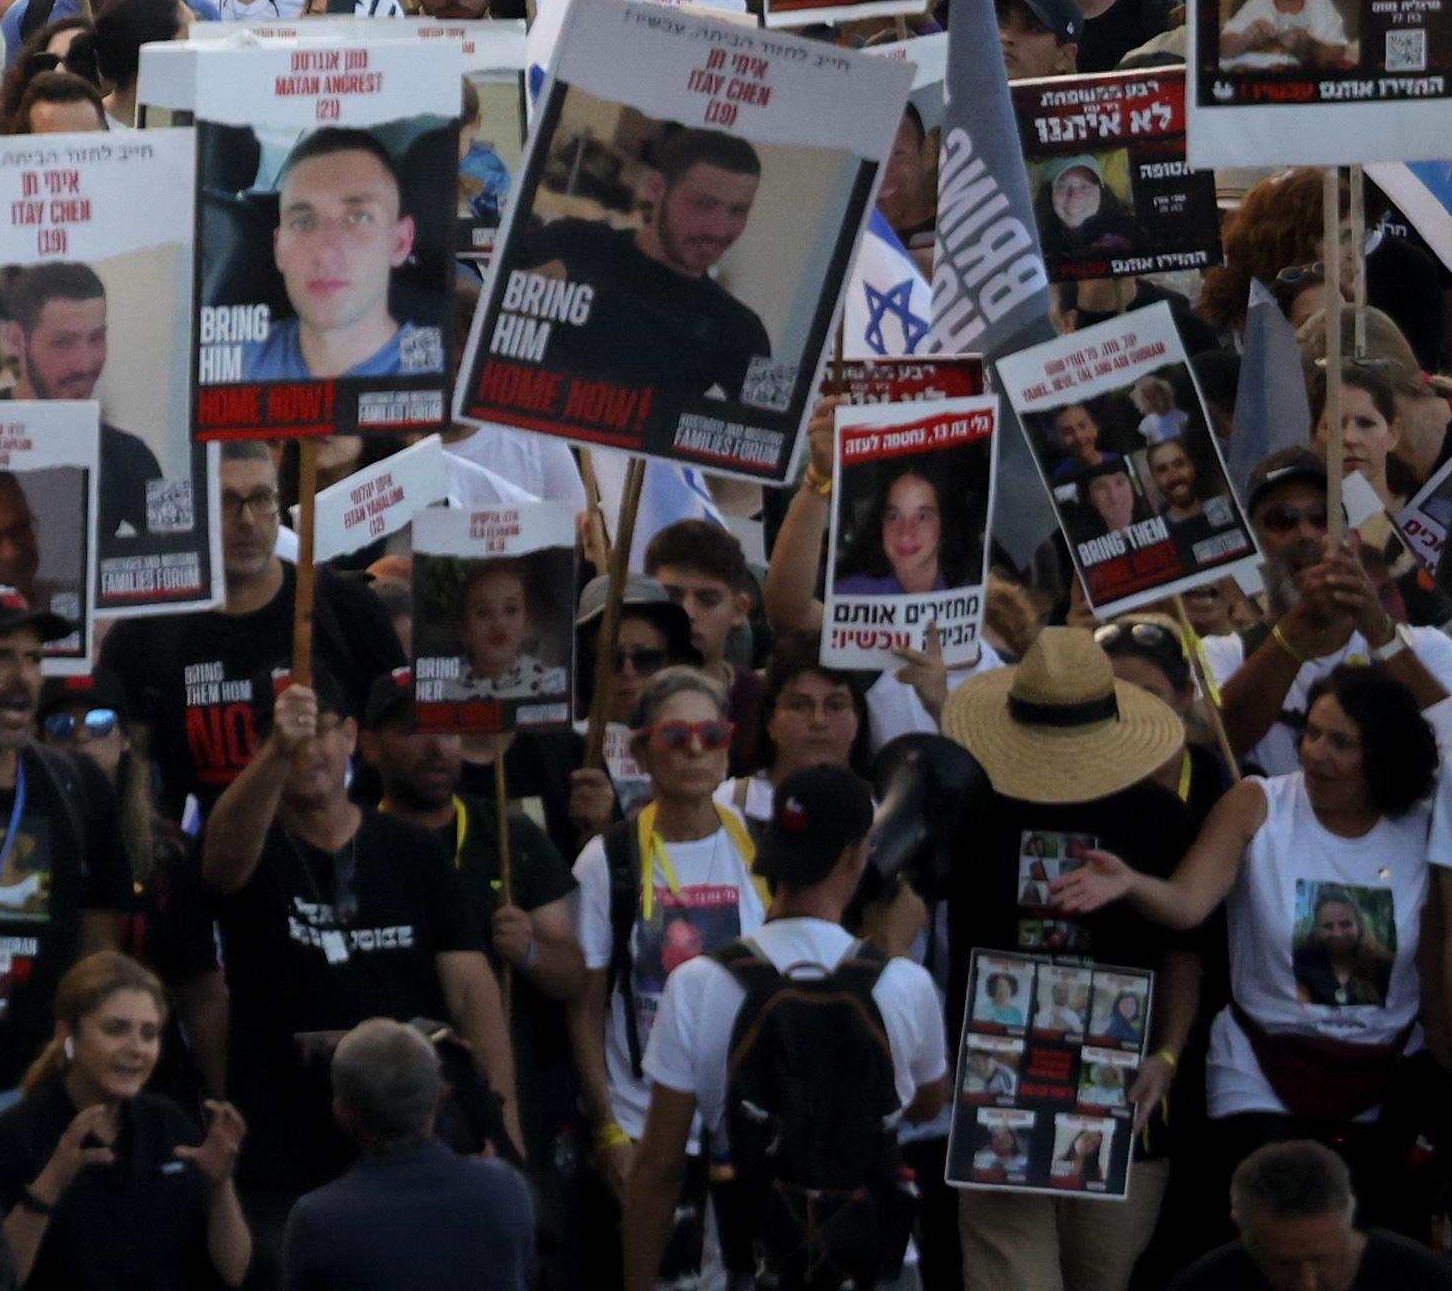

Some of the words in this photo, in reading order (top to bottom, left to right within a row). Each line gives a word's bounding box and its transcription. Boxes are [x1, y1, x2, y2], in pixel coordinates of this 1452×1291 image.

[703, 49, 723, 71] חן
[728, 51, 769, 79] איתי
[274, 72, 325, 97] MATAN
[329, 72, 383, 95] ANGREST
[686, 68, 726, 96] ITAY
[728, 78, 770, 108] CHEN
[1039, 82, 1127, 107] ממשפחת
[1131, 79, 1159, 97] רבע
[1317, 75, 1384, 97] אותם
[1388, 72, 1443, 95] החזירו
[314, 94, 339, 117] (21)
[703, 96, 739, 127] (19)
[1124, 103, 1171, 132] לא
[1032, 112, 1120, 144] איתנו
[21, 170, 39, 193] חן
[46, 168, 79, 193] איתי
[10, 201, 44, 225] ITAY
[48, 198, 91, 223] CHEN
[36, 228, 66, 254] (19)
[500, 268, 593, 326] BRING
[200, 300, 271, 342] BRING
[489, 311, 550, 364] HIM
[198, 337, 243, 382] HIM
[198, 384, 264, 422] HOME
[271, 378, 334, 420] NOW!
[478, 361, 562, 411] HOME
[566, 380, 653, 430] NOW!
[950, 423, 967, 437] בת
[972, 418, 991, 433] גלי
[673, 424, 731, 458] FAMILIES
[730, 434, 778, 465] FORUM
[845, 437, 879, 455] לעזה
[882, 431, 923, 451] נחטפה
[343, 505, 368, 528] EITAN
[368, 516, 385, 536] (12)
[1076, 526, 1125, 565] BRING
[1124, 513, 1169, 553] THEM
[101, 570, 153, 594] FAMILIES
[155, 568, 199, 590] FORUM
[833, 599, 897, 623] אותם
[903, 592, 979, 624] מחזירים
[183, 660, 224, 682] BRING
[416, 657, 460, 680] BRING
[185, 680, 219, 704] THEM
[416, 679, 444, 701] HER
